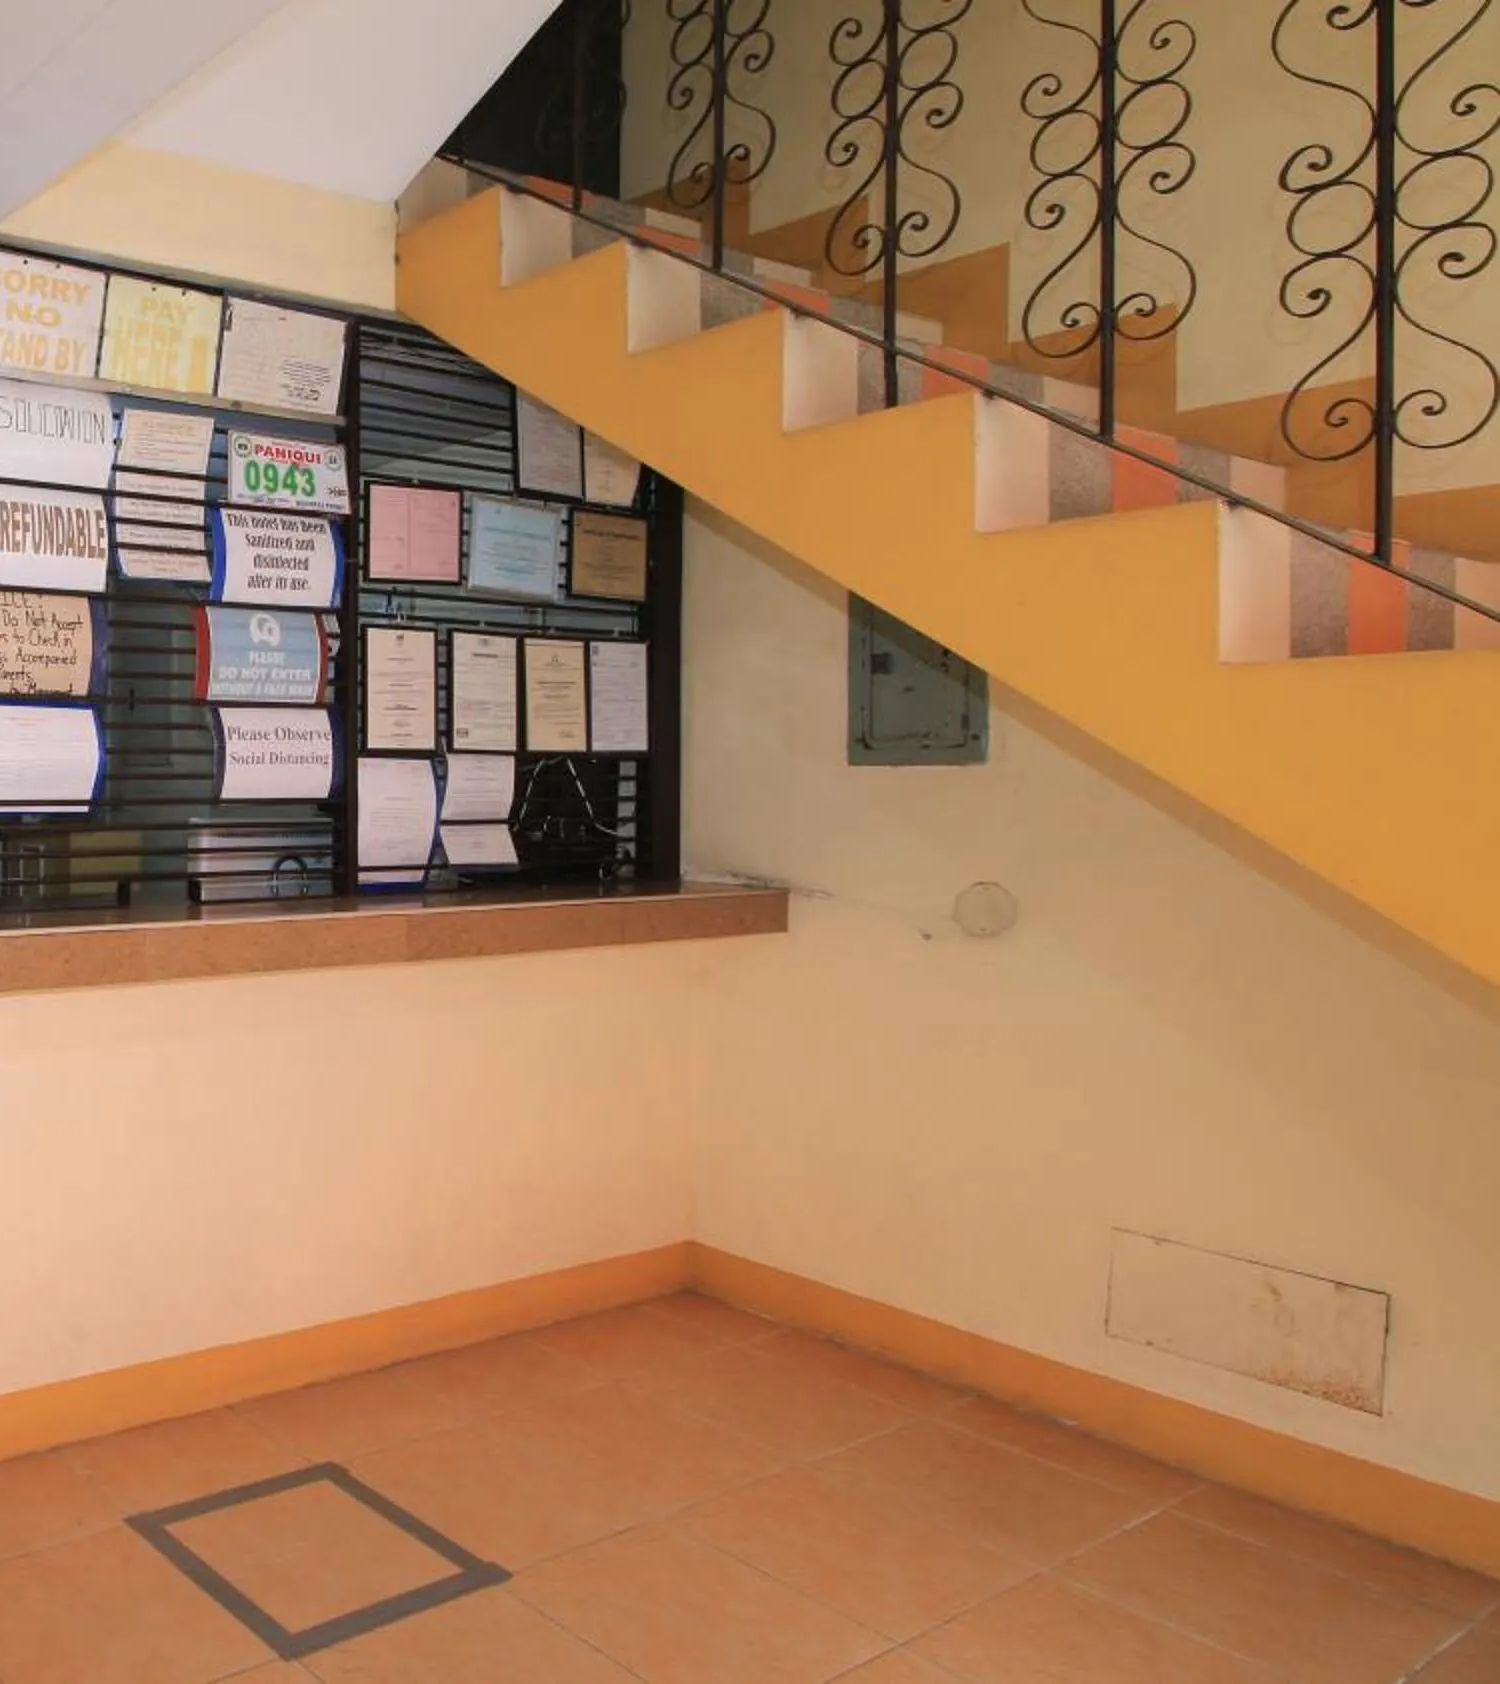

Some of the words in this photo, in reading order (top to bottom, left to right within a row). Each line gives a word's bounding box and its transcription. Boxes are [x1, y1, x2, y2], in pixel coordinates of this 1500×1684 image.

[6, 299, 62, 328] NO
[141, 298, 193, 325] PAY
[55, 337, 87, 373] BY
[254, 443, 321, 465] PANIQUI
[243, 459, 316, 497] 0943
[2, 608, 19, 627] Do
[227, 725, 271, 741] Please
[274, 726, 331, 741] Observe
[229, 751, 266, 766] Social
[269, 750, 329, 767] Distancing
